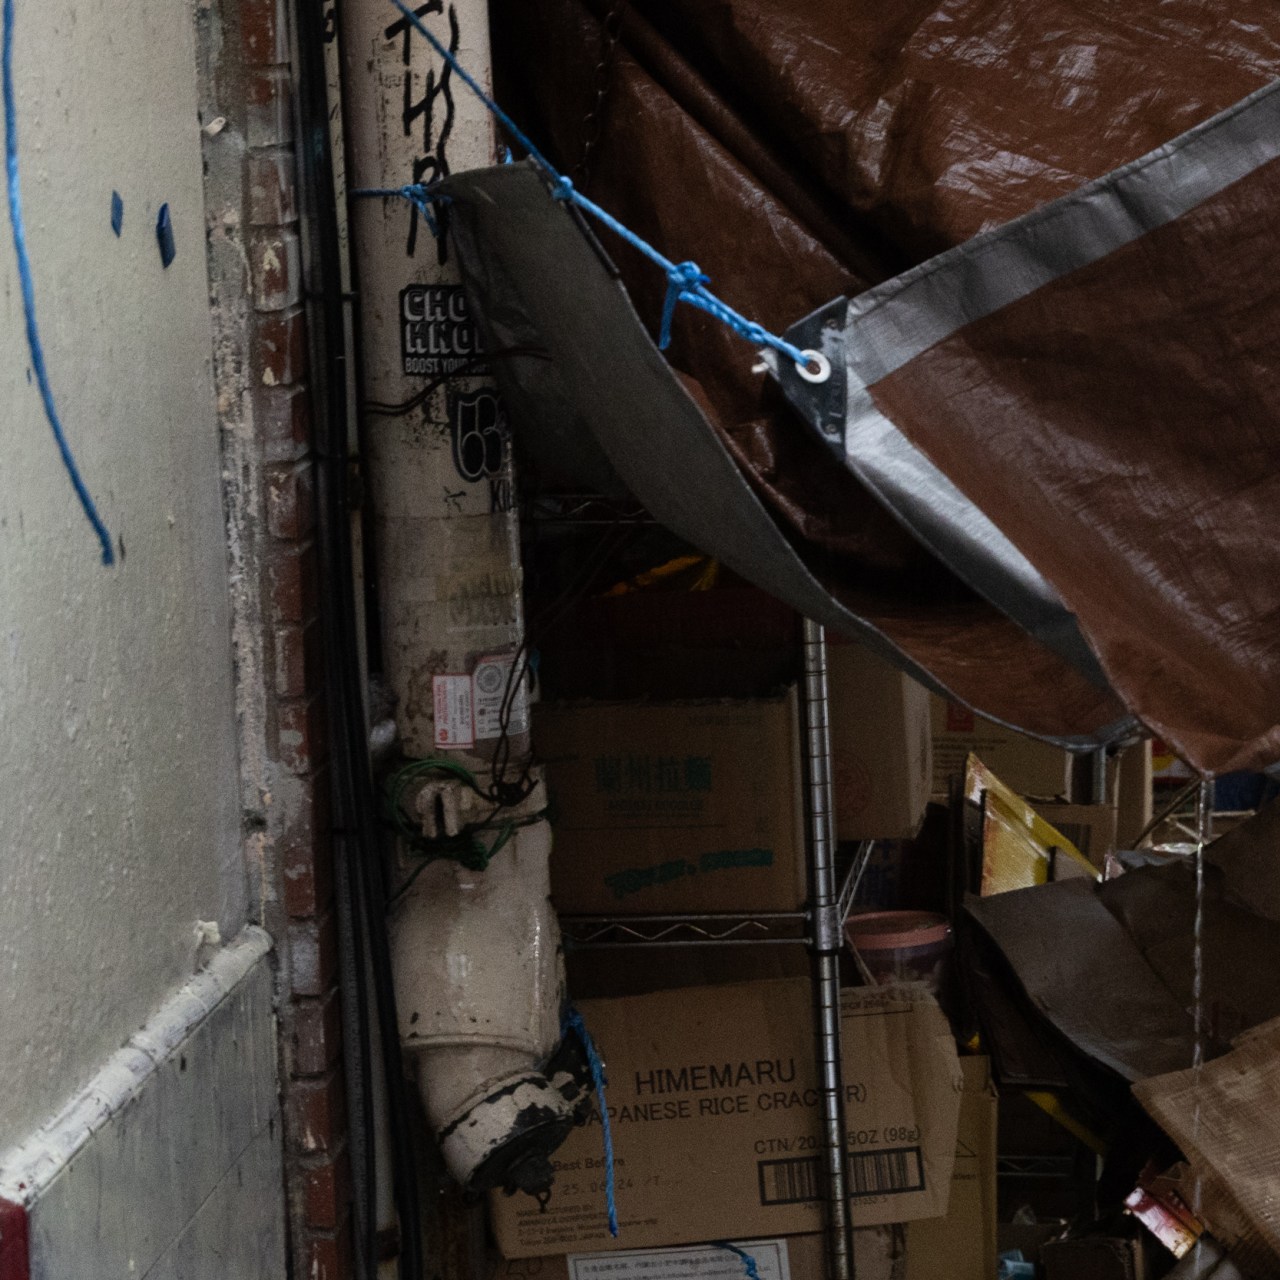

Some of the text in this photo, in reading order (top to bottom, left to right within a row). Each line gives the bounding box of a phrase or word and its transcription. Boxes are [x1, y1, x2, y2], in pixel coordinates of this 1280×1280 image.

[635, 1058, 798, 1096] HIMEMARU
[699, 1096, 750, 1116] RICE
[585, 1155, 626, 1170] Befre
